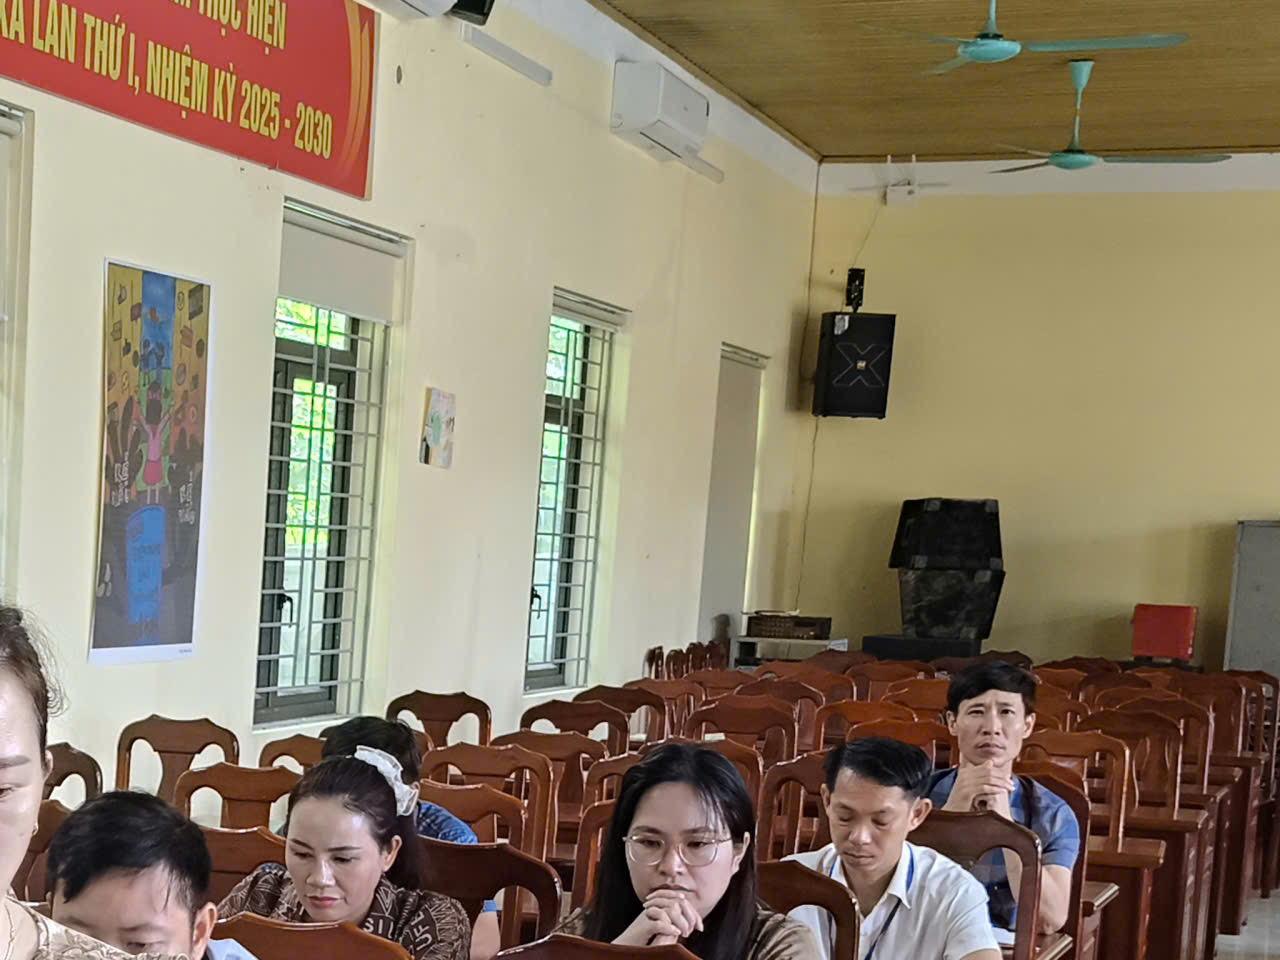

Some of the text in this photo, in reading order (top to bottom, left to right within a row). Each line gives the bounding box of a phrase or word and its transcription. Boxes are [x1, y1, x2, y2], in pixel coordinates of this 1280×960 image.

[84, 14, 126, 80] THỨ
[128, 32, 140, 95] I,
[146, 40, 209, 119] NHIỆM
[212, 62, 237, 123] KỲ
[239, 79, 281, 139] 2025
[294, 102, 332, 159] 2030
